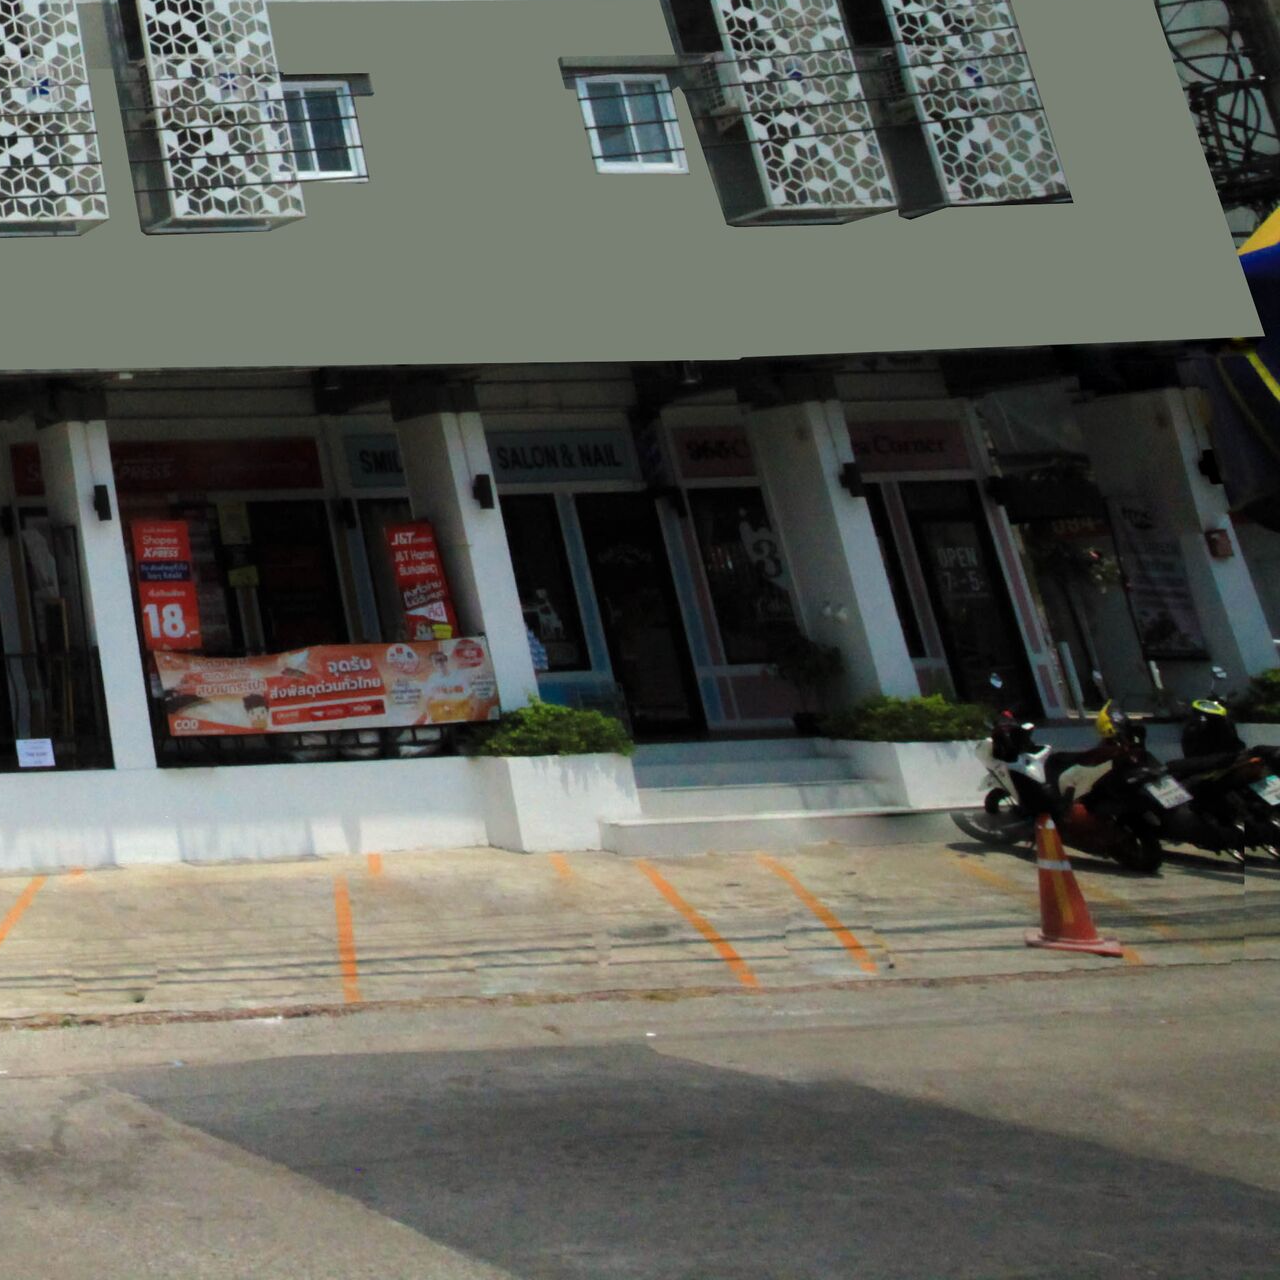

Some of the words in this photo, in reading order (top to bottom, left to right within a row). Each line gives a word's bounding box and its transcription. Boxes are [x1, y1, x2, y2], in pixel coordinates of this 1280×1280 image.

[497, 445, 558, 470] SALON
[559, 444, 574, 467] &
[577, 442, 622, 468] NAIL
[937, 547, 979, 568] OPEN
[173, 719, 199, 730] COD
